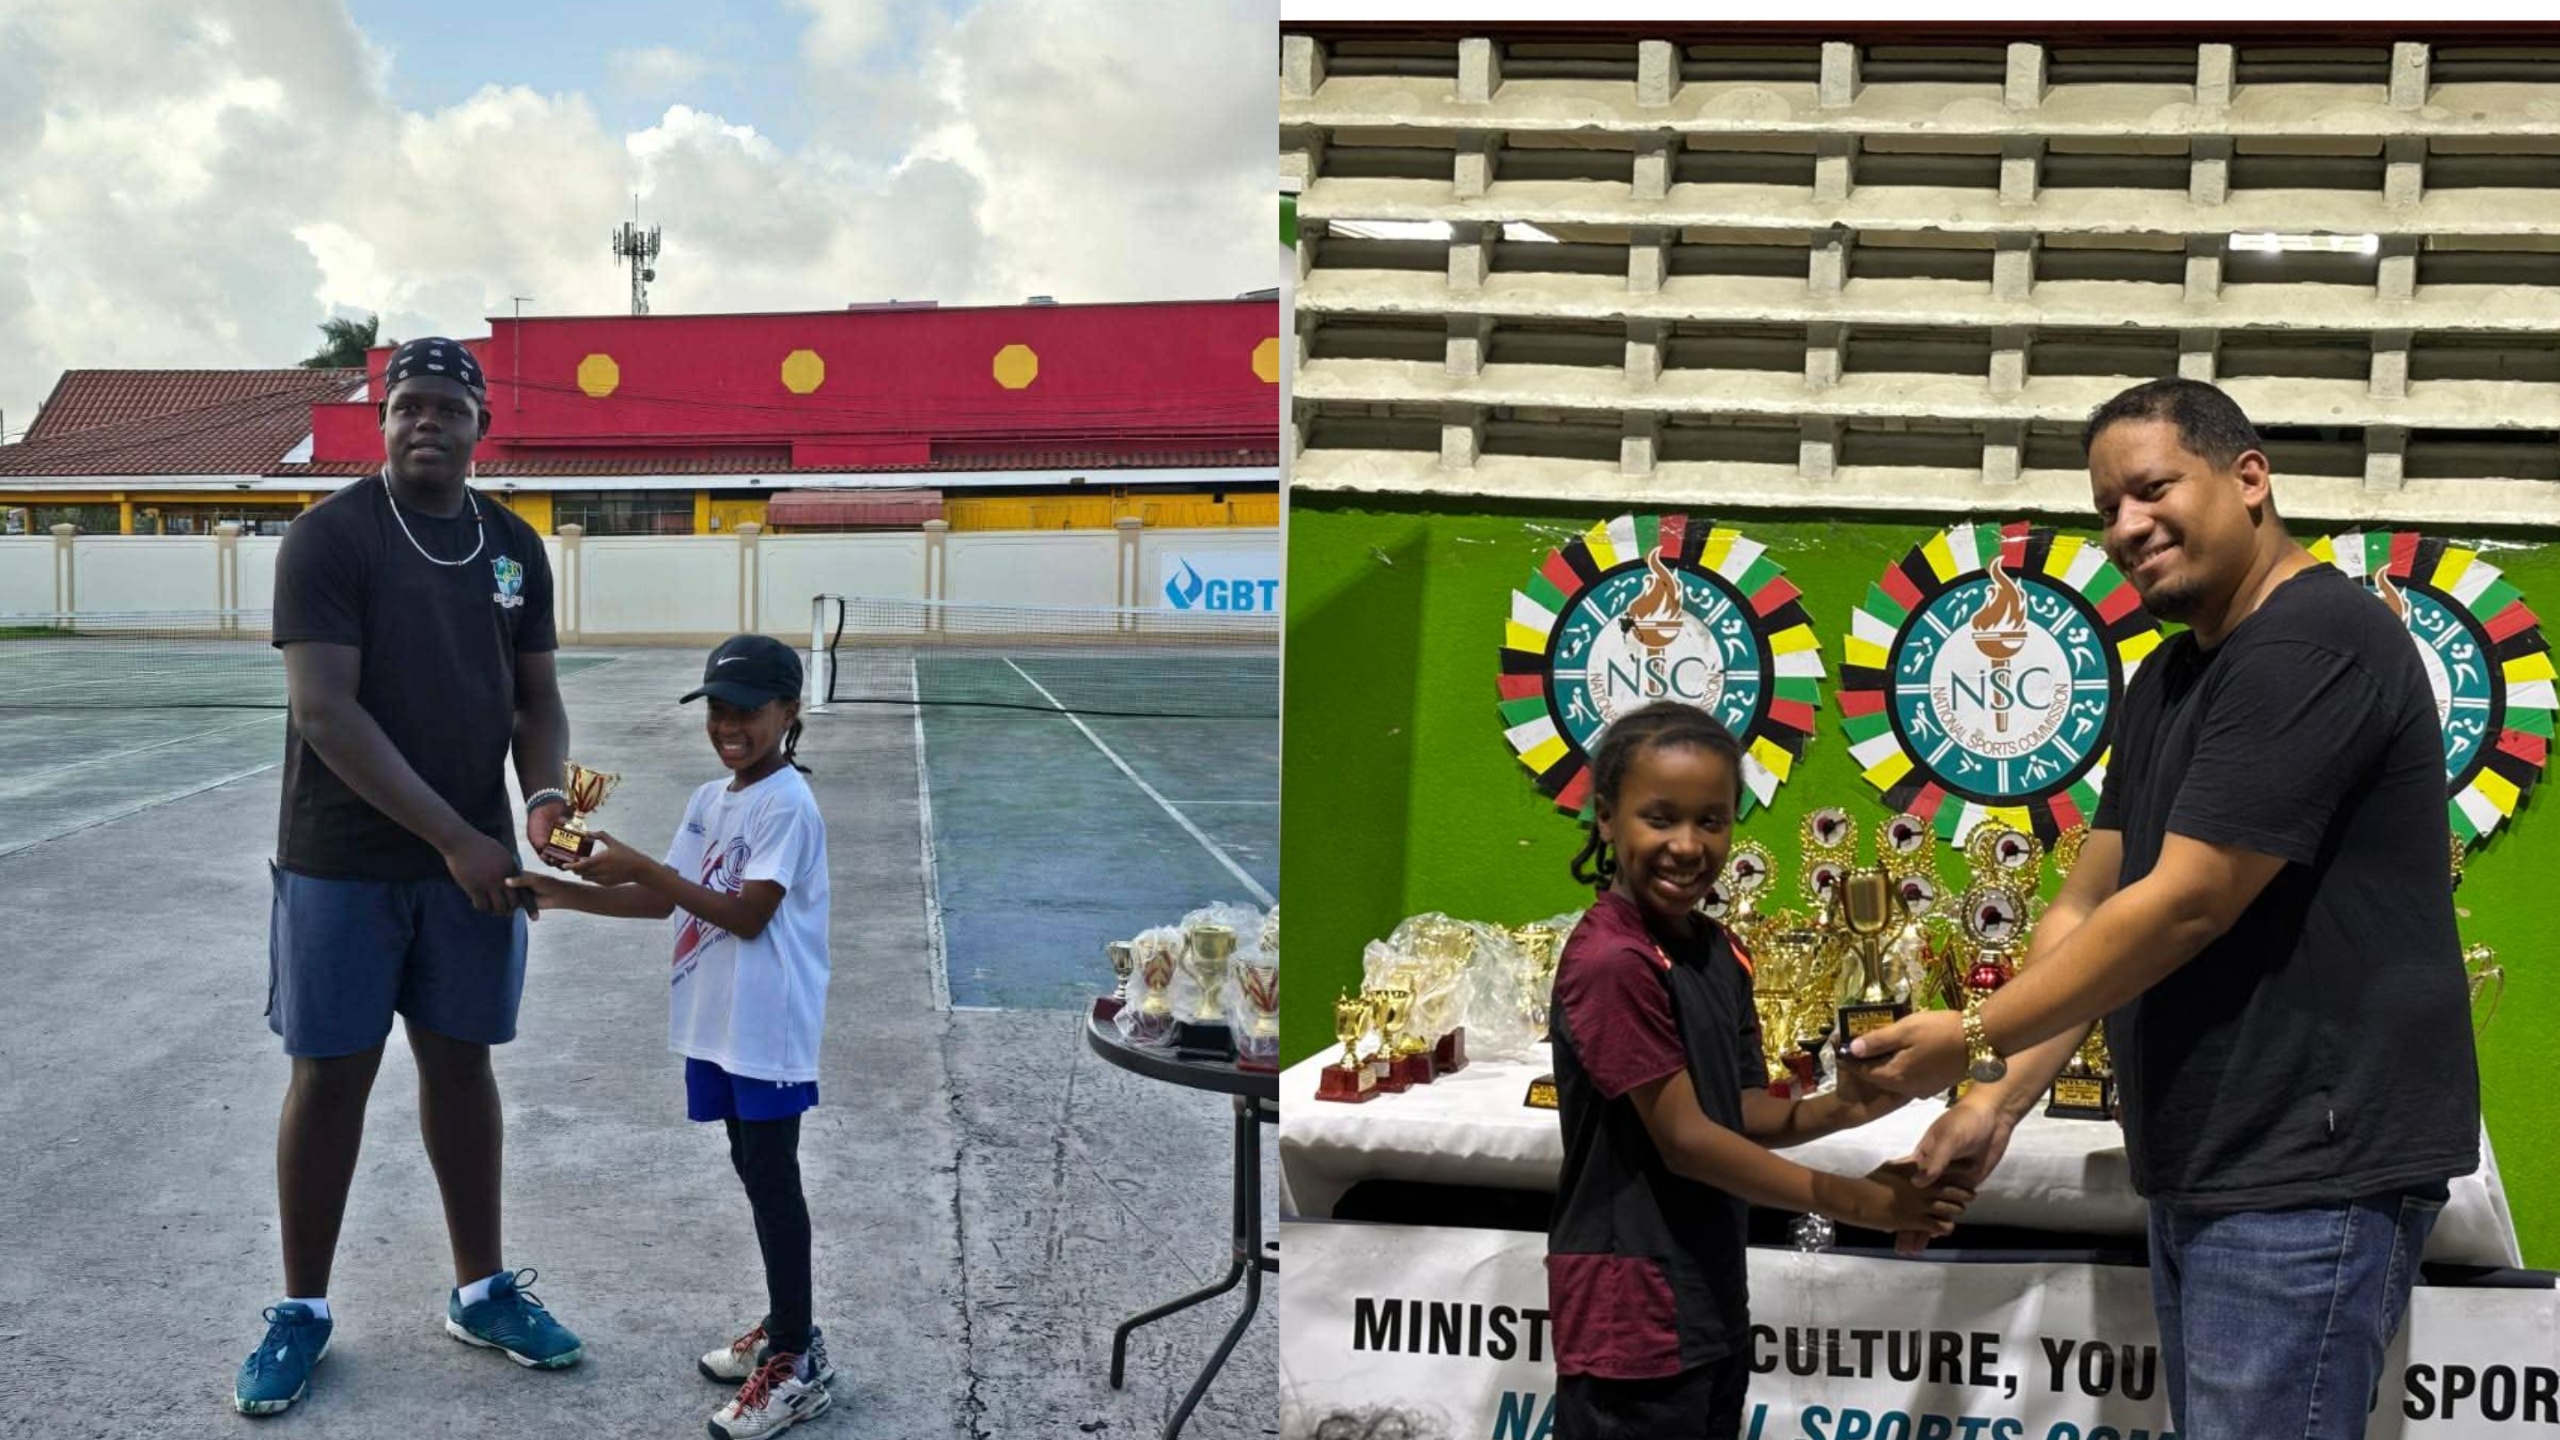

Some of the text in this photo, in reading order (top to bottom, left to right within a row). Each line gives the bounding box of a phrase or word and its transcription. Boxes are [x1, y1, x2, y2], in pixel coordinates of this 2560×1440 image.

[1590, 673, 1617, 724] NATIONA
[1607, 656, 1708, 699] NSC
[1951, 666, 2050, 711] NSC
[1933, 683, 2069, 756] NATIONAL SPORTS COMMISSION
[1353, 1297, 1553, 1363] MINIST
[1749, 1323, 2018, 1400] CULTURE,
[2040, 1337, 2157, 1402] YOU
[2402, 1363, 2560, 1424] SPOR
